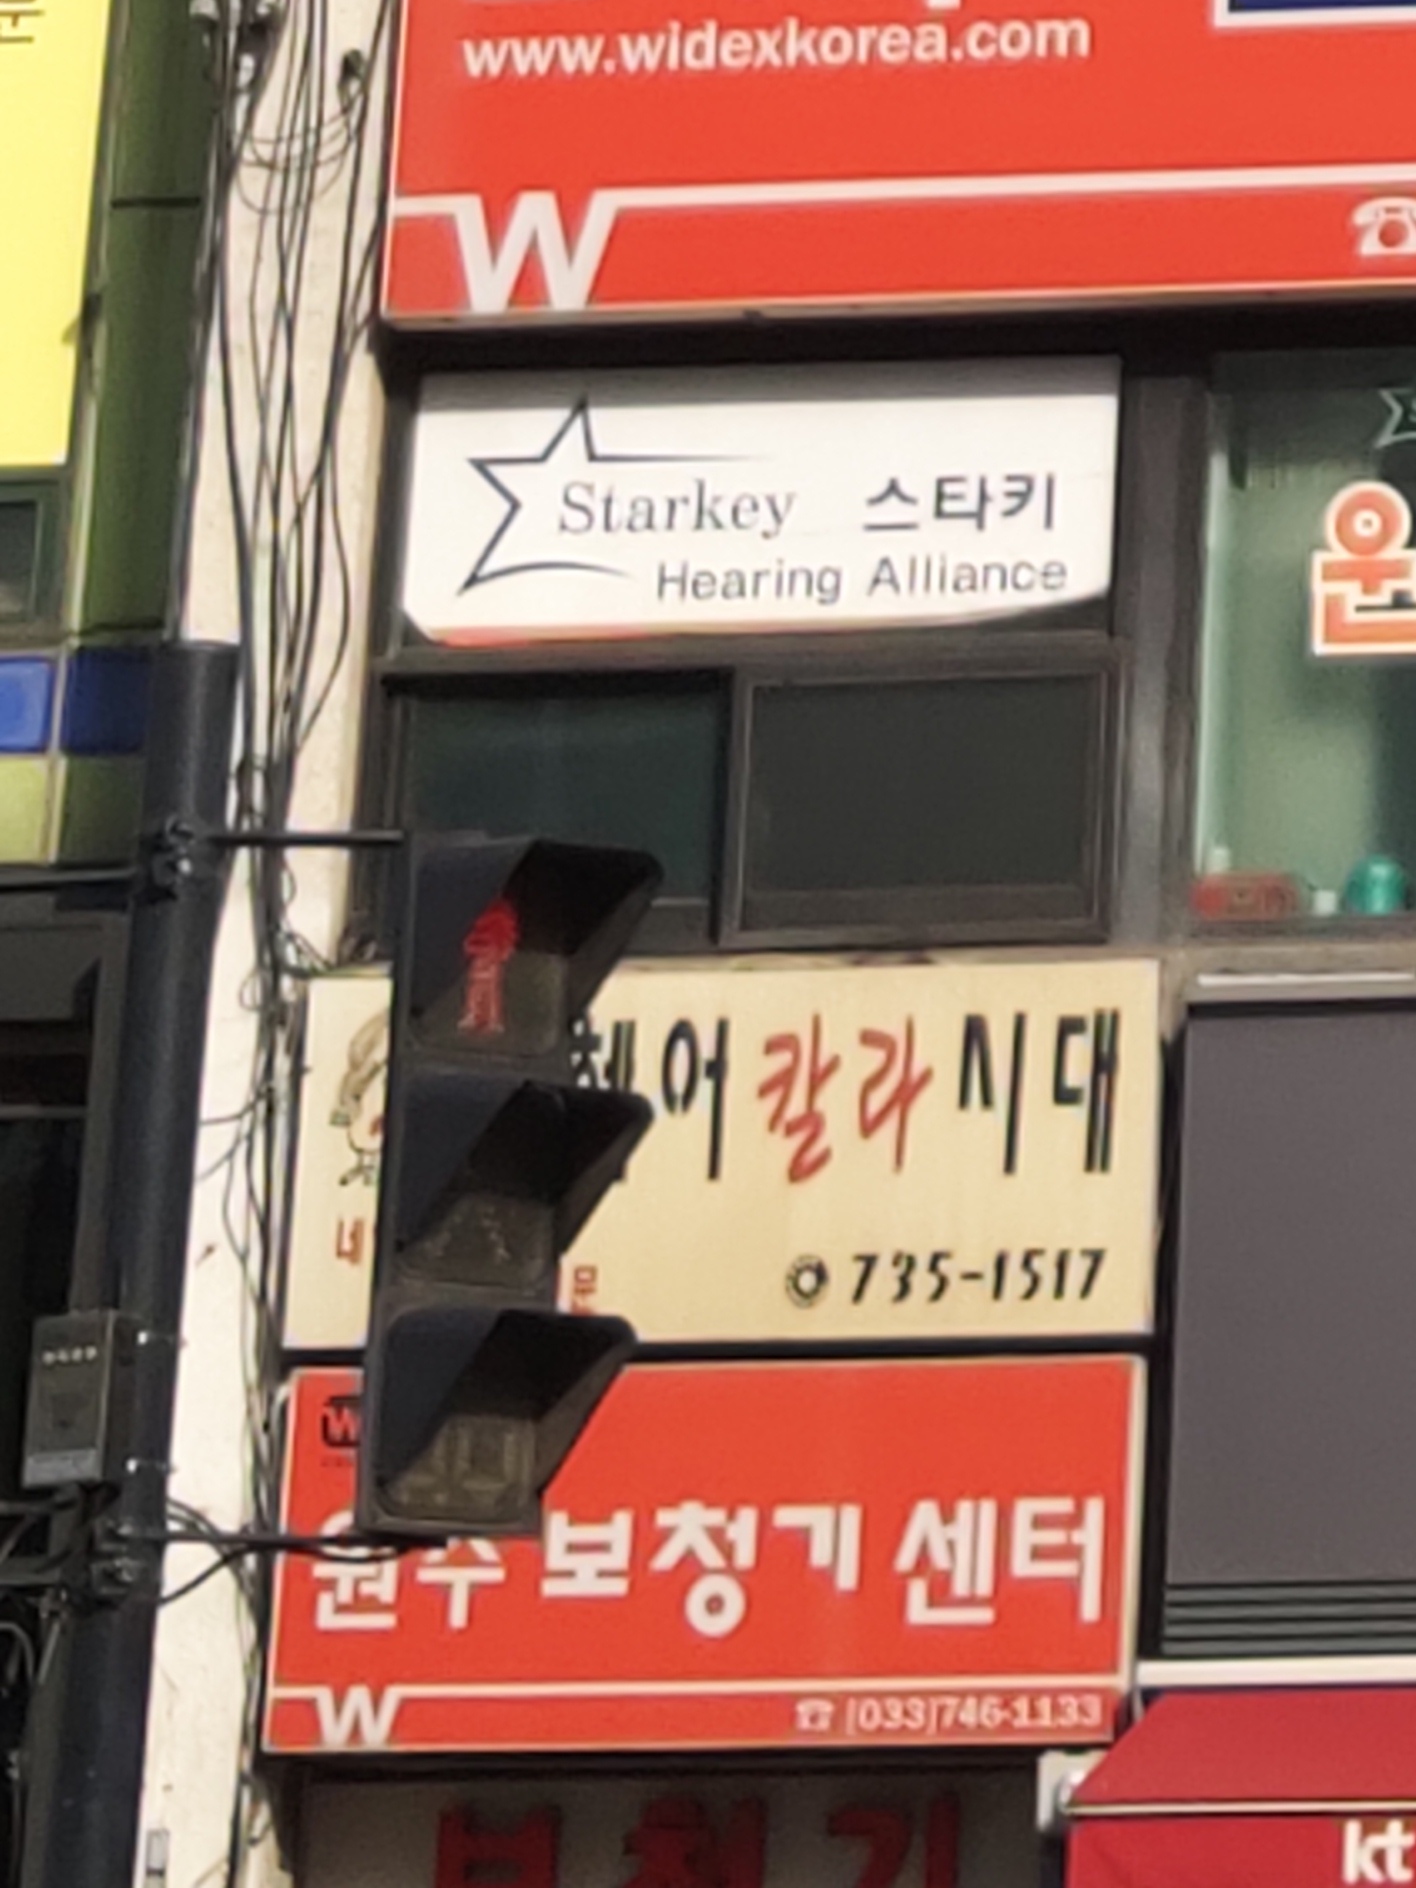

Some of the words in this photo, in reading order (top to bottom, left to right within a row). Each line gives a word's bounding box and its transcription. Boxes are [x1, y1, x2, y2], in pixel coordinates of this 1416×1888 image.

[463, 18, 1090, 78] www.widexkorea.com
[558, 479, 797, 540] Starkey
[863, 471, 1057, 533] 스타키
[656, 559, 842, 605] Hearing
[866, 555, 1069, 599] Alliance
[850, 1248, 1107, 1306] 735-1517
[540, 1499, 863, 1637] 보청기
[893, 1495, 1106, 1626] 센터
[1341, 1819, 1416, 1885] kt
